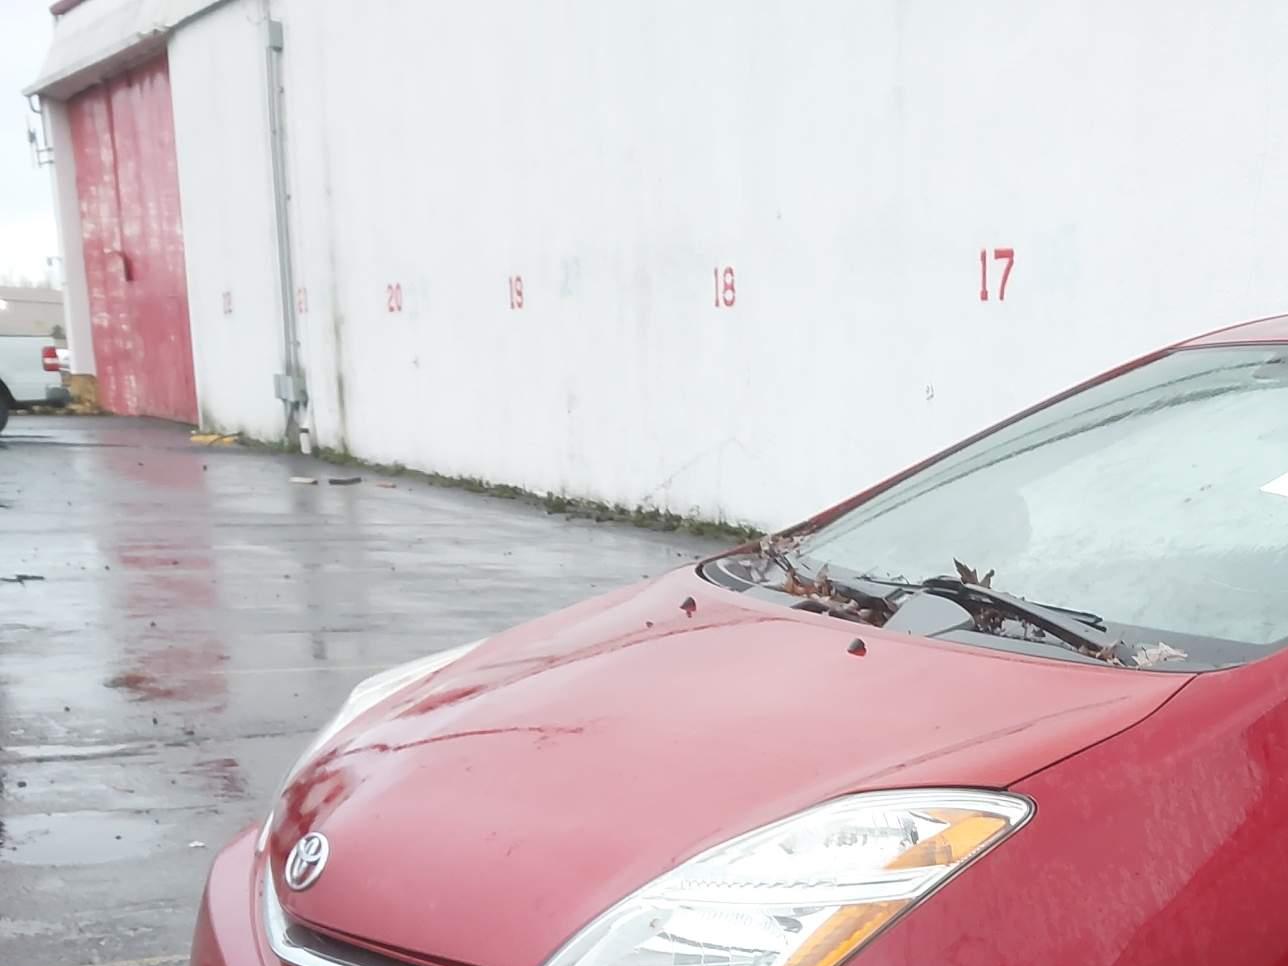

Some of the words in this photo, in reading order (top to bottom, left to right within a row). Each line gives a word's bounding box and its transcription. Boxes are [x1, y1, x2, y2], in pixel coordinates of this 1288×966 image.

[509, 275, 523, 309] 19
[714, 266, 736, 307] 18
[980, 247, 1015, 301] 17
[387, 282, 402, 312] 20
